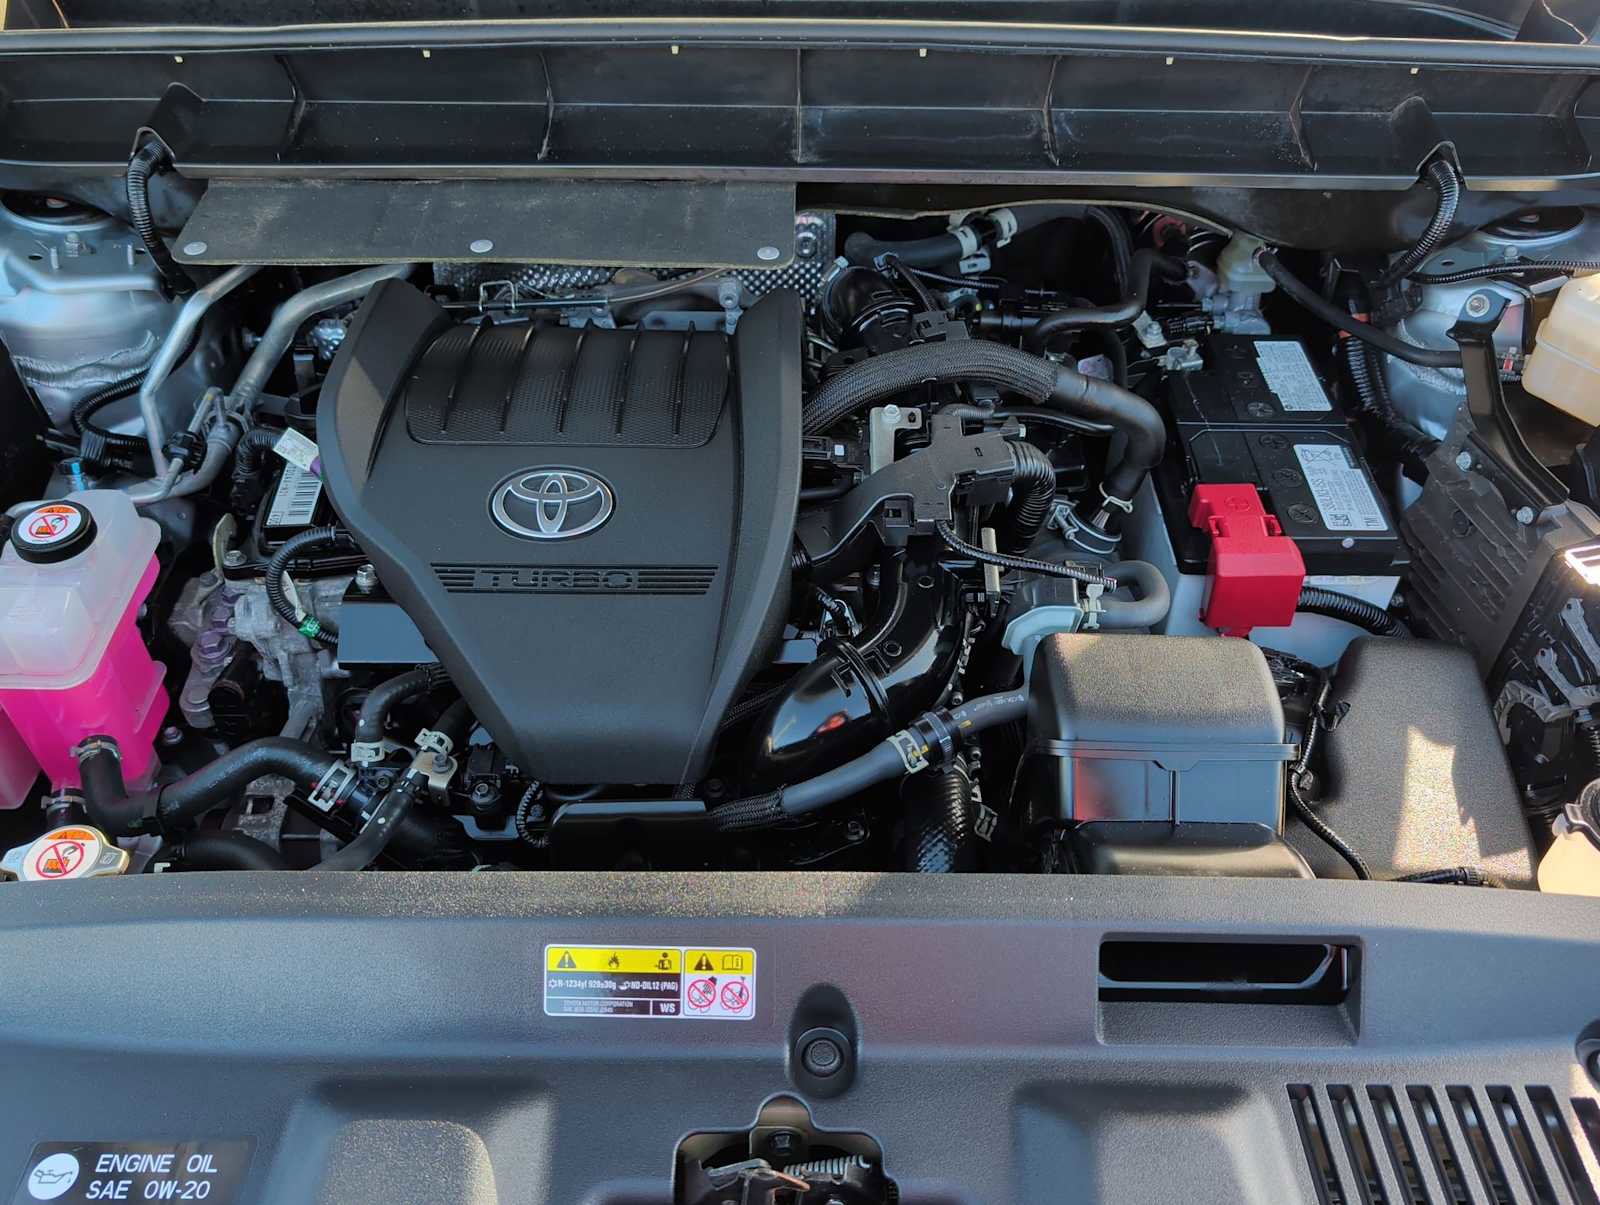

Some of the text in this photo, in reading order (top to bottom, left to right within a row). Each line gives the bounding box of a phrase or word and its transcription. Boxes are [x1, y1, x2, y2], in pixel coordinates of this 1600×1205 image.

[480, 569, 633, 589] TURBO
[660, 980, 679, 992] (PAG)
[660, 1002, 676, 1013] WS
[95, 1153, 218, 1173] ENGINE OIL
[85, 1180, 211, 1200] SAE 0W-20
